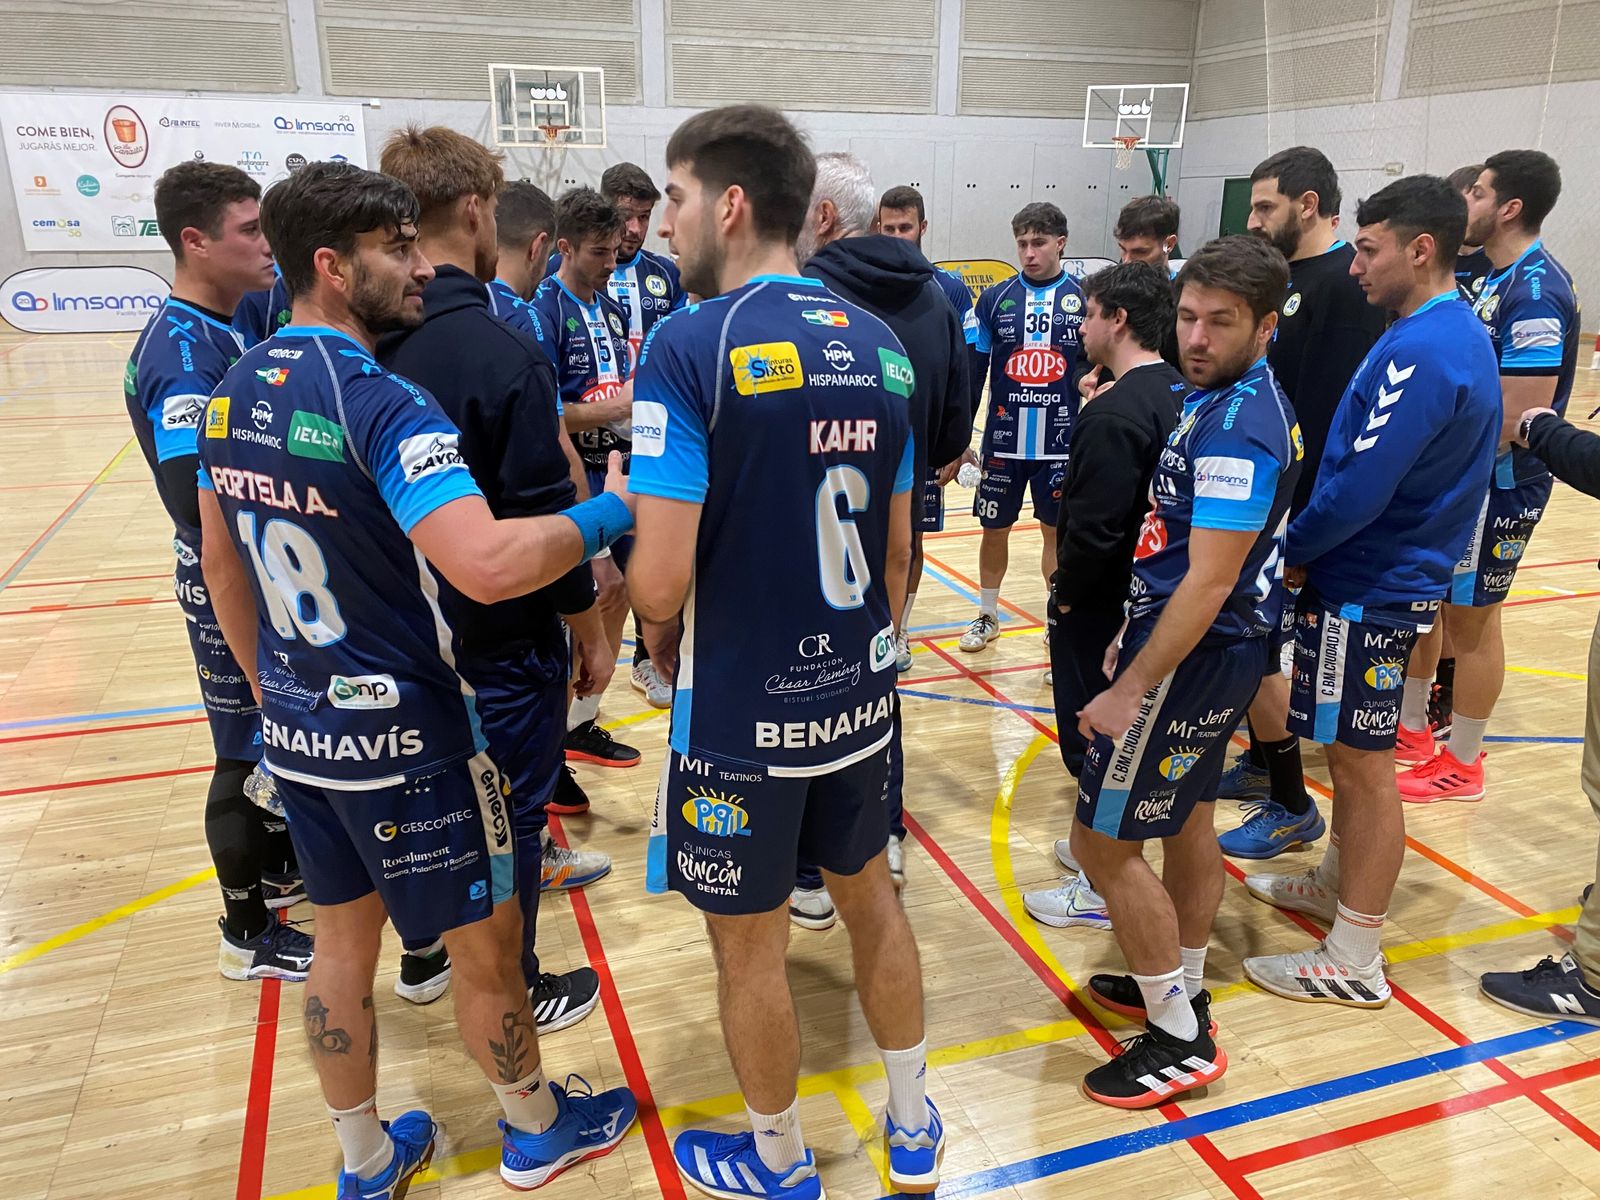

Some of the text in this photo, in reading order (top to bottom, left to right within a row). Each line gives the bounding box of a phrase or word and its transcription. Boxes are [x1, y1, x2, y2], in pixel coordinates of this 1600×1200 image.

[16, 126, 95, 140] COME BIEN,
[295, 117, 355, 132] limsama
[19, 141, 62, 152] JUGARÁS
[138, 219, 163, 237] TE
[1025, 312, 1051, 334] 36
[594, 336, 612, 363] 15
[751, 360, 795, 379] Sixto
[1006, 352, 1066, 377] TROPS
[808, 373, 878, 387] HISPAMAROC
[1008, 388, 1061, 406] málaga
[809, 418, 878, 454] KAHR
[210, 466, 302, 513] PORTELA
[979, 497, 999, 519] 36
[1493, 516, 1519, 529] Mr
[815, 463, 871, 611] 6
[236, 509, 348, 648] 18
[798, 633, 834, 658] CR
[1364, 632, 1393, 649] Mr
[764, 674, 811, 692] César
[1166, 708, 1233, 739] Mr Jeff
[261, 714, 424, 762] ENAHAVÍS
[718, 771, 762, 782] TEATINOS
[400, 809, 473, 834] GESCONTEC
[683, 841, 732, 859] CLINICAS
[411, 861, 442, 873] Palacios
[697, 883, 739, 896] DENTAL
